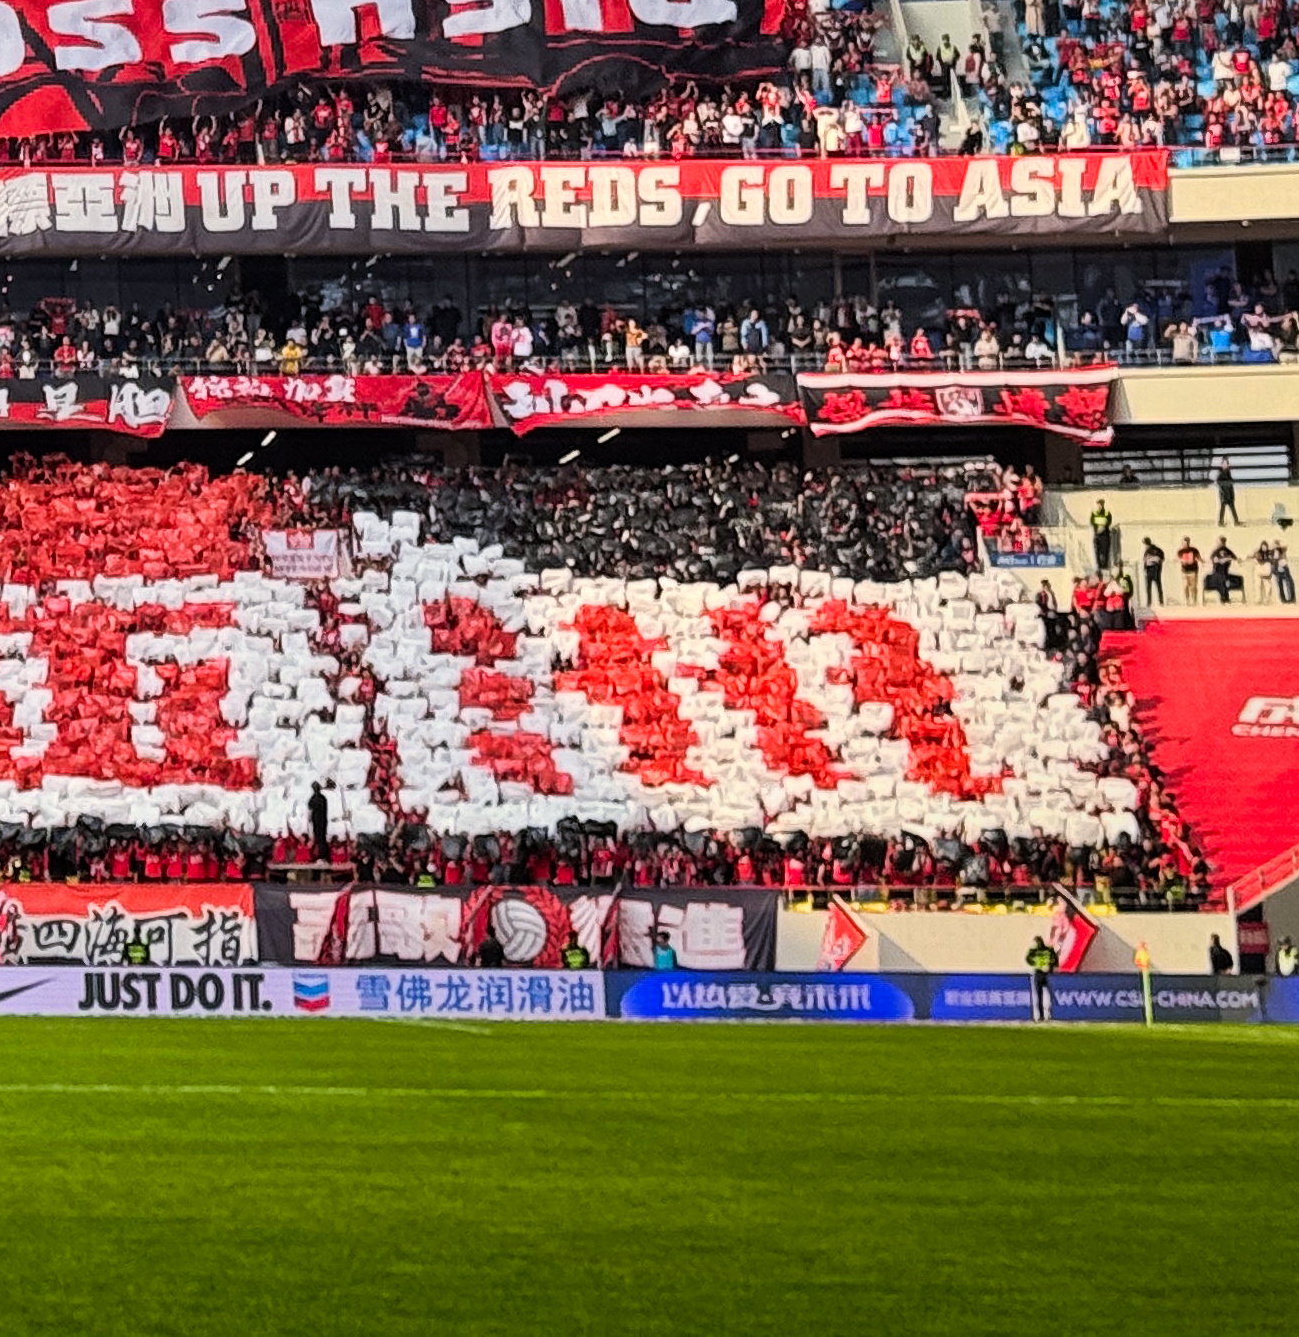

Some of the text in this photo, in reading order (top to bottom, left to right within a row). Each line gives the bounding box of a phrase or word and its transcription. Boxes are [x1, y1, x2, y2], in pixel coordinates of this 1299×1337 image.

[199, 170, 298, 233] UP
[313, 170, 470, 232] THE
[830, 161, 935, 224] TO
[955, 156, 1144, 220] ASIA
[78, 972, 273, 1012] JUST DO IT.
[356, 974, 596, 1013] 雪佛龙润滑油
